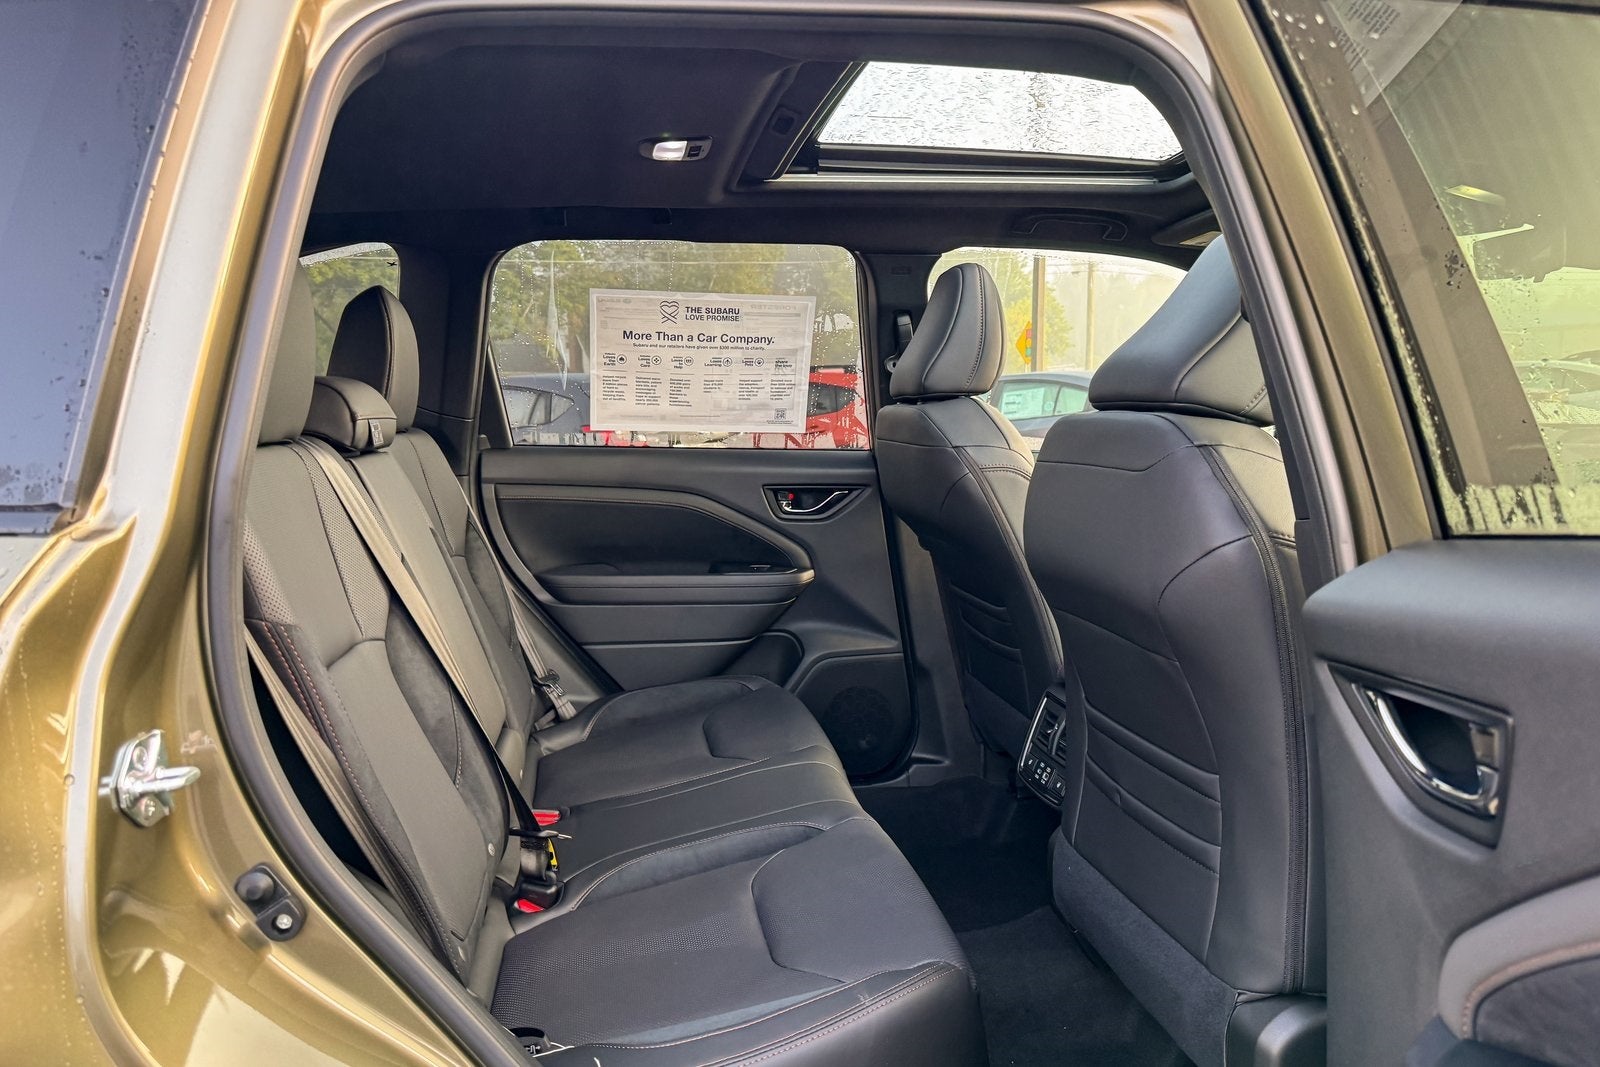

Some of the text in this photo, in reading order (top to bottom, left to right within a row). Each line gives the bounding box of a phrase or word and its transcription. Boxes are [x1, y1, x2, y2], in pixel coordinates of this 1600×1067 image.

[685, 306, 703, 314] THE
[705, 307, 740, 315] SUBARU
[623, 330, 652, 341] More
[655, 331, 684, 342] Than
[697, 332, 718, 343] Car
[720, 333, 775, 345] Company.
